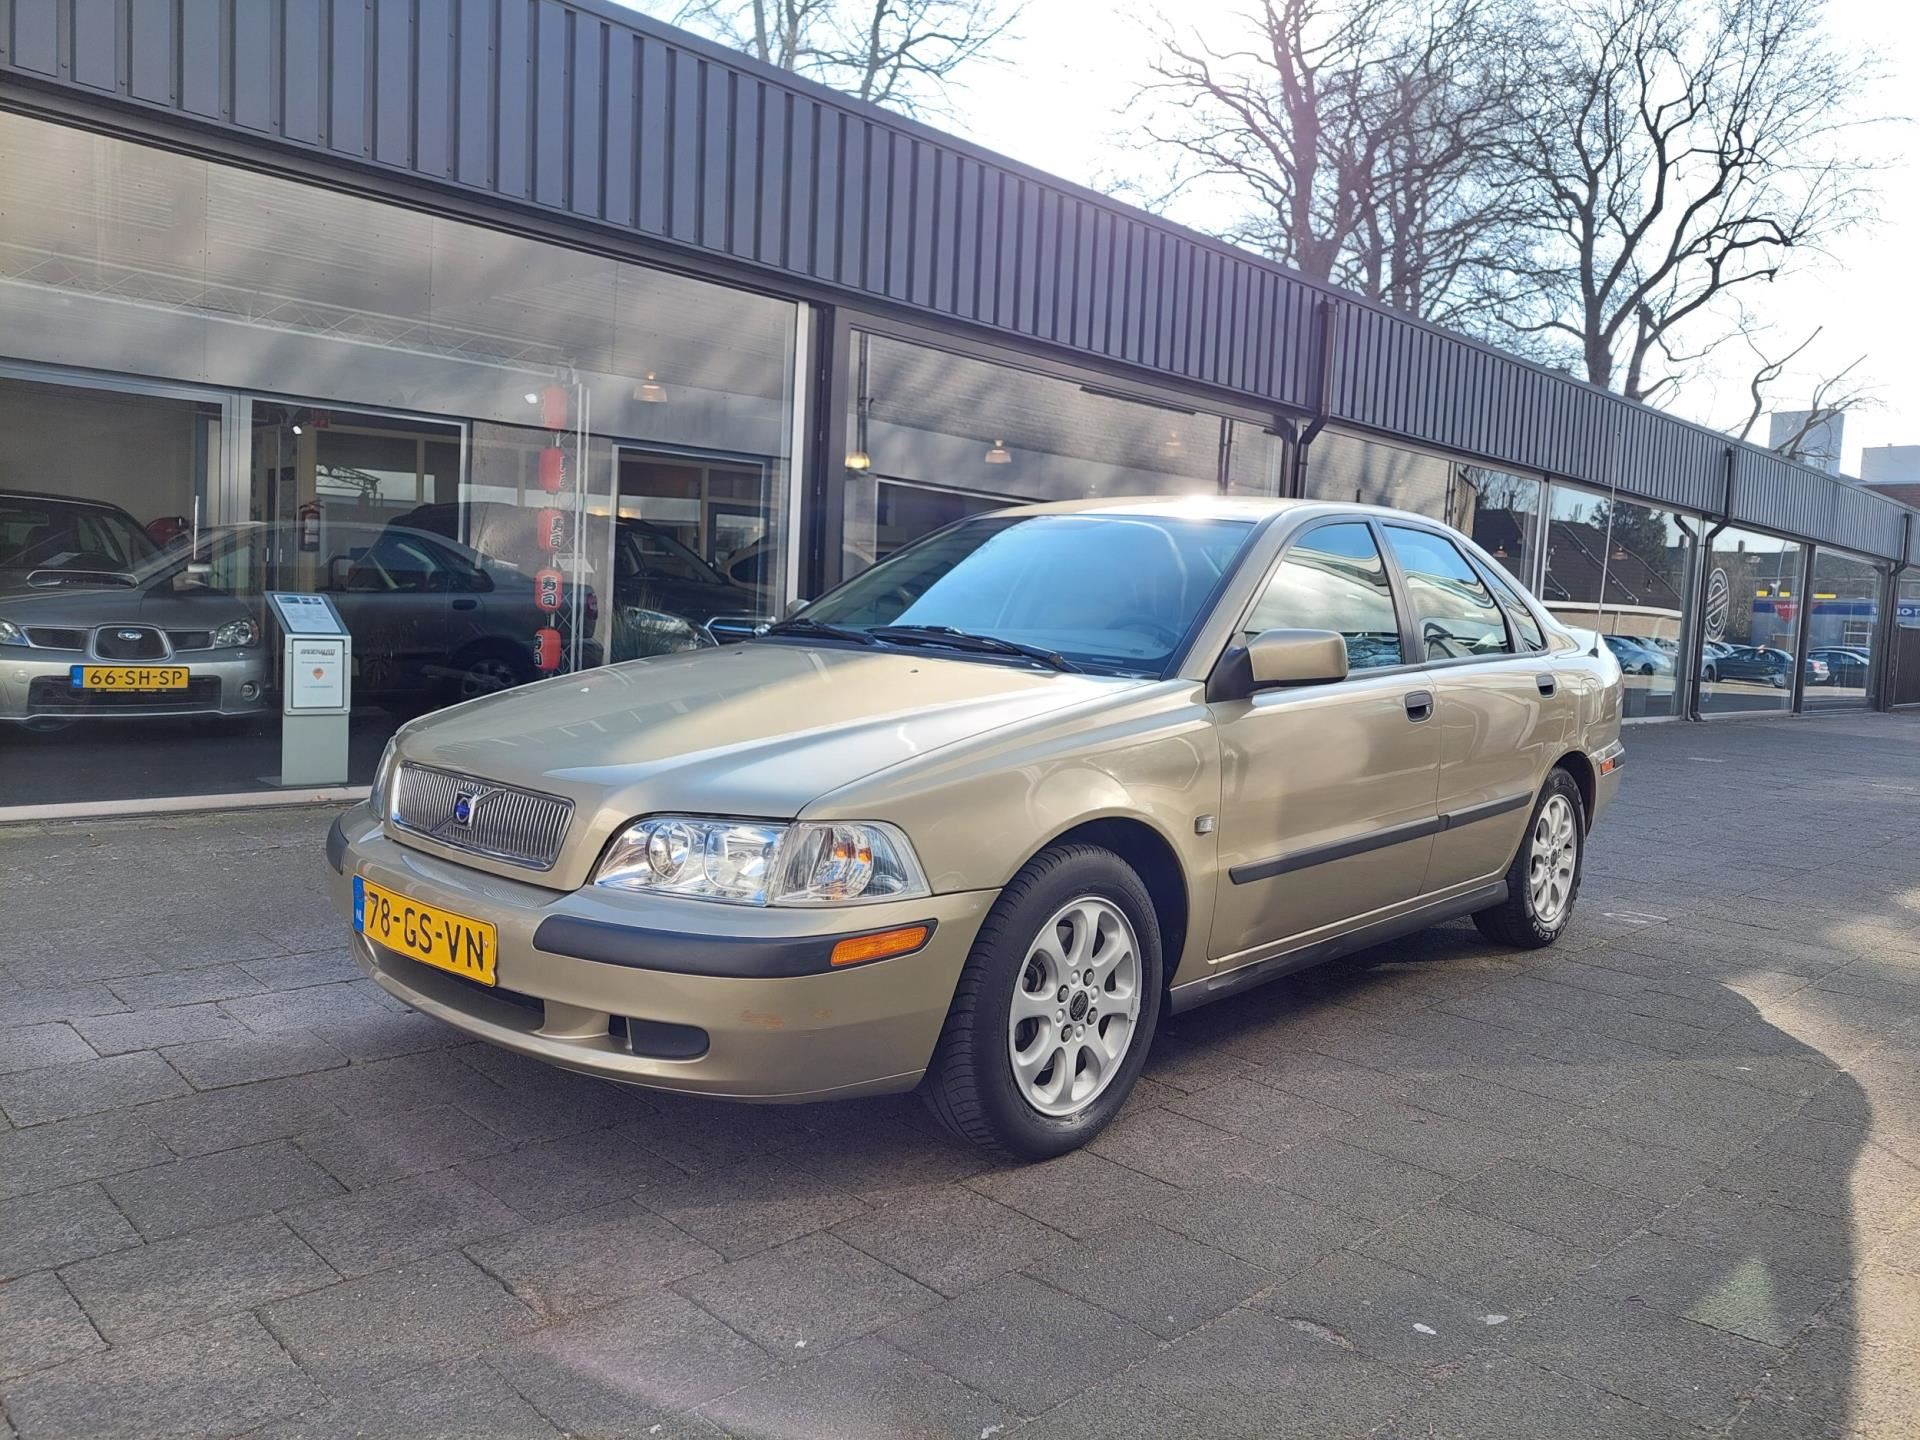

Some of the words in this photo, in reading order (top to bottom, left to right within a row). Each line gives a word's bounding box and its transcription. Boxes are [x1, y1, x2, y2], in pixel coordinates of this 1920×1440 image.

[90, 670, 183, 686] 66-SH-SP
[355, 908, 364, 922] NL
[368, 890, 485, 973] 78-GS-VN
